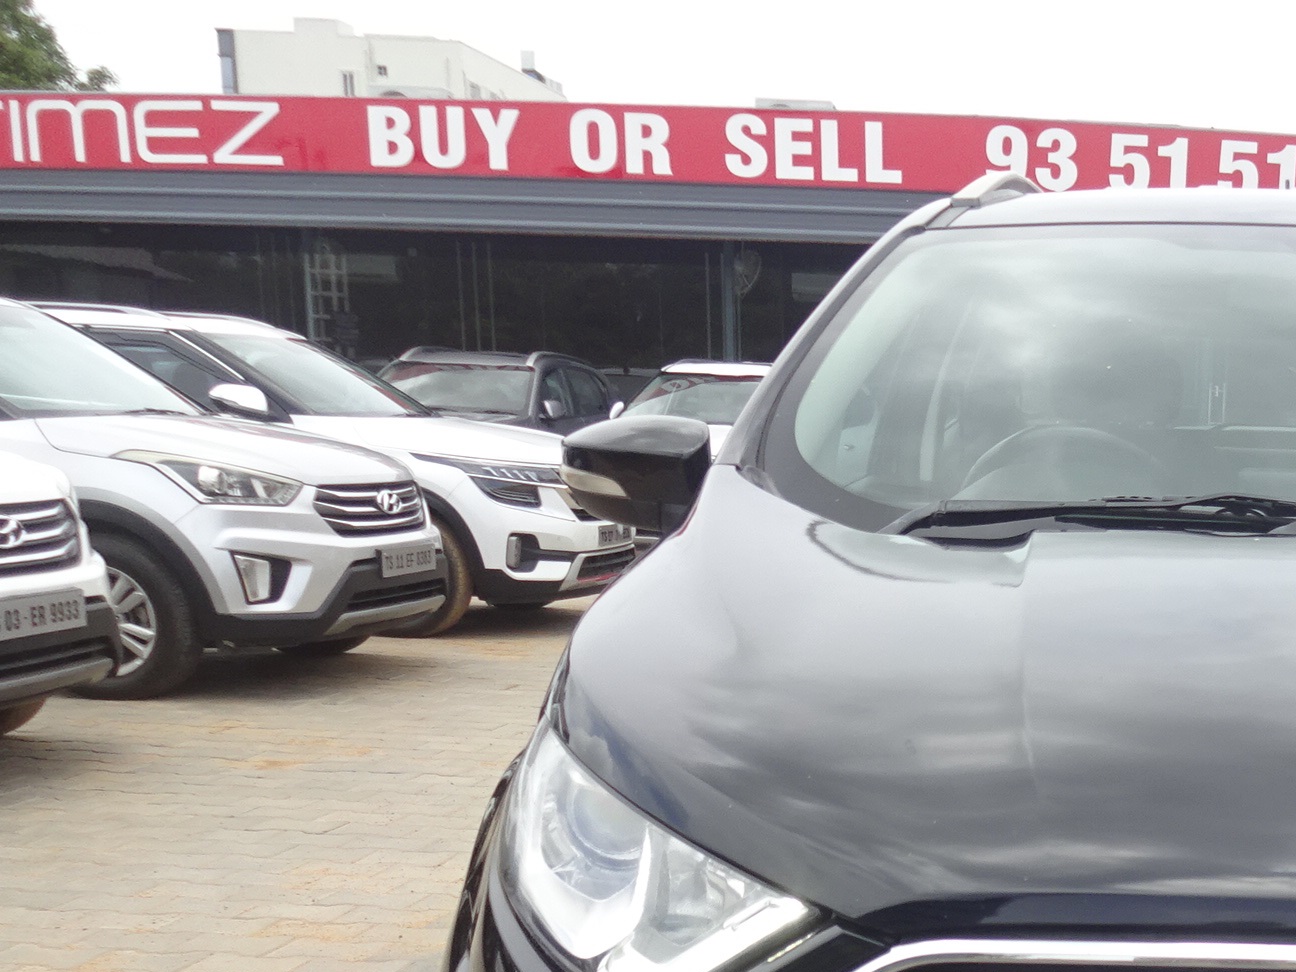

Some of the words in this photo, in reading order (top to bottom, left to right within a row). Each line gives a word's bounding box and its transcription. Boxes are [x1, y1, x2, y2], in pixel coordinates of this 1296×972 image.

[0, 99, 285, 166] IMEZ
[367, 105, 520, 172] BUY
[569, 108, 674, 176] OR
[725, 113, 903, 184] SELL
[985, 125, 1078, 192] 93
[1108, 133, 1189, 190] 51
